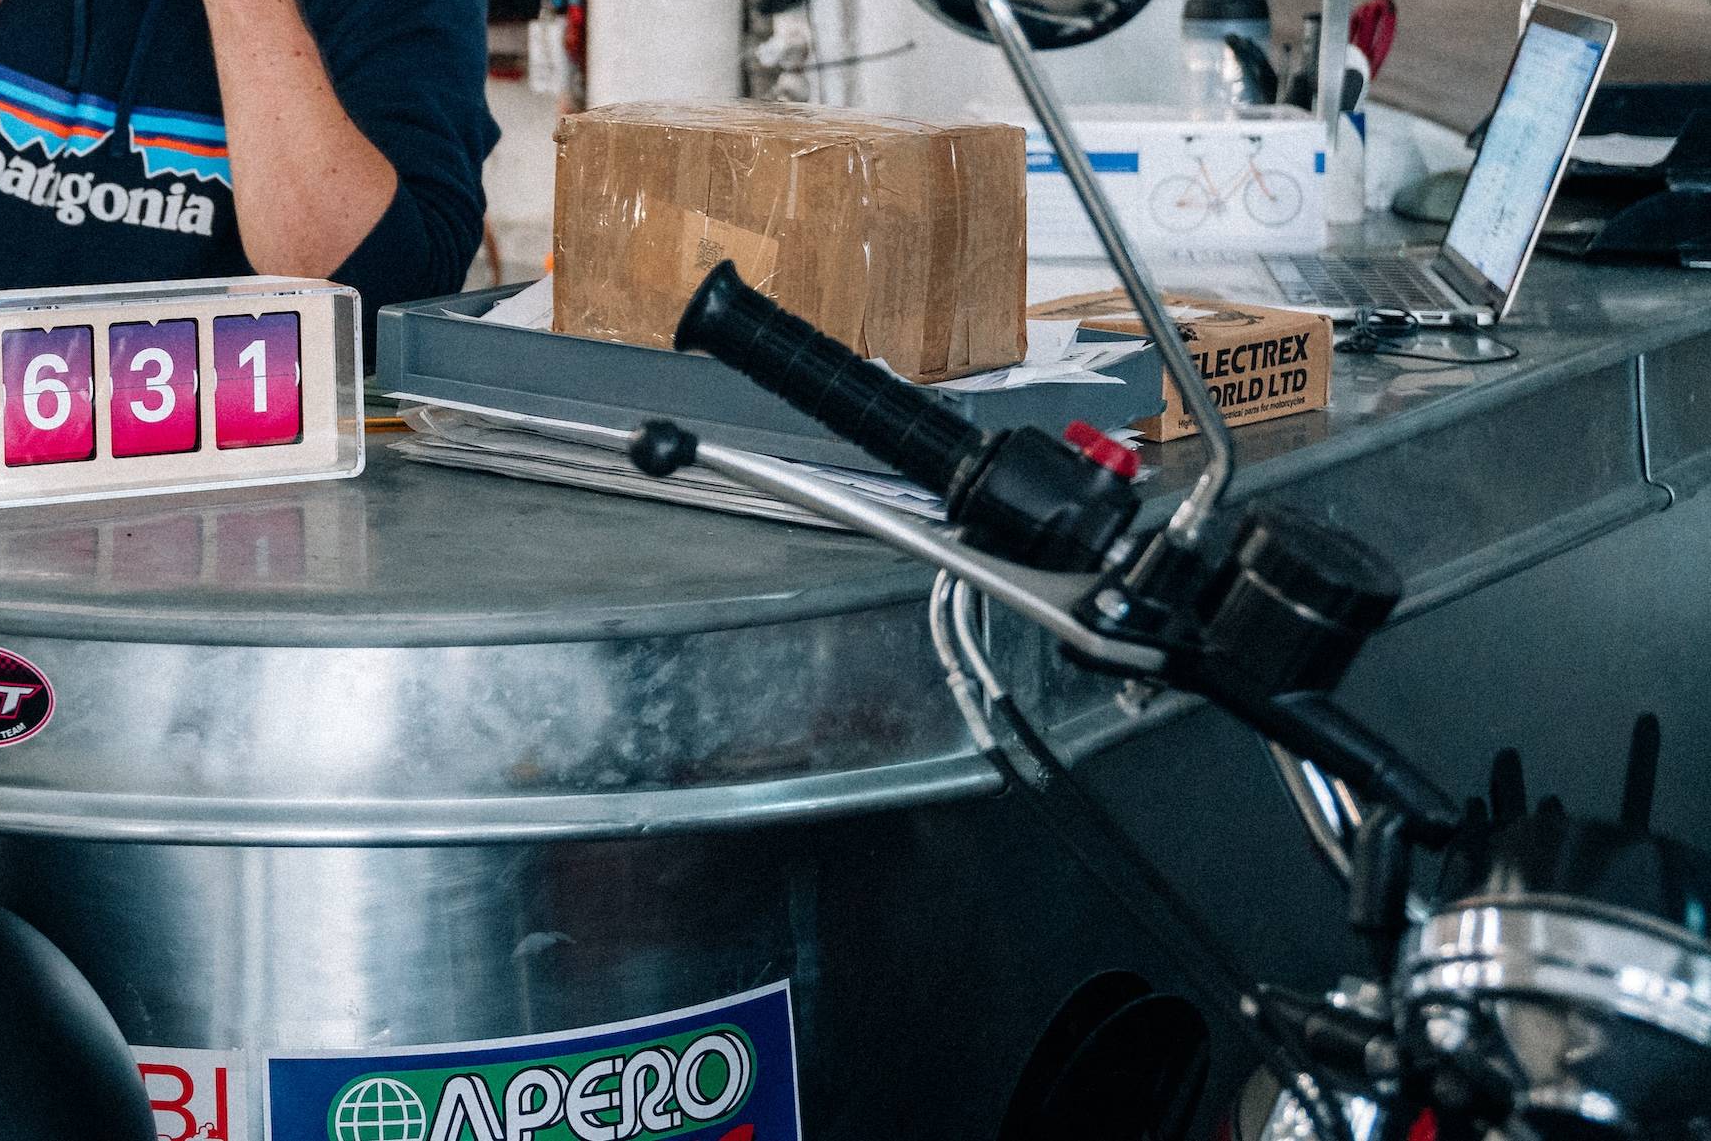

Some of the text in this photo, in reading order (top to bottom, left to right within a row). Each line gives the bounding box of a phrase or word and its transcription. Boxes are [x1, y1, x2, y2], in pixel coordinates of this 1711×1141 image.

[1183, 368, 1308, 415] ORLD LTD
[1, 722, 27, 740] TEAM
[428, 1030, 753, 1141] APERO
